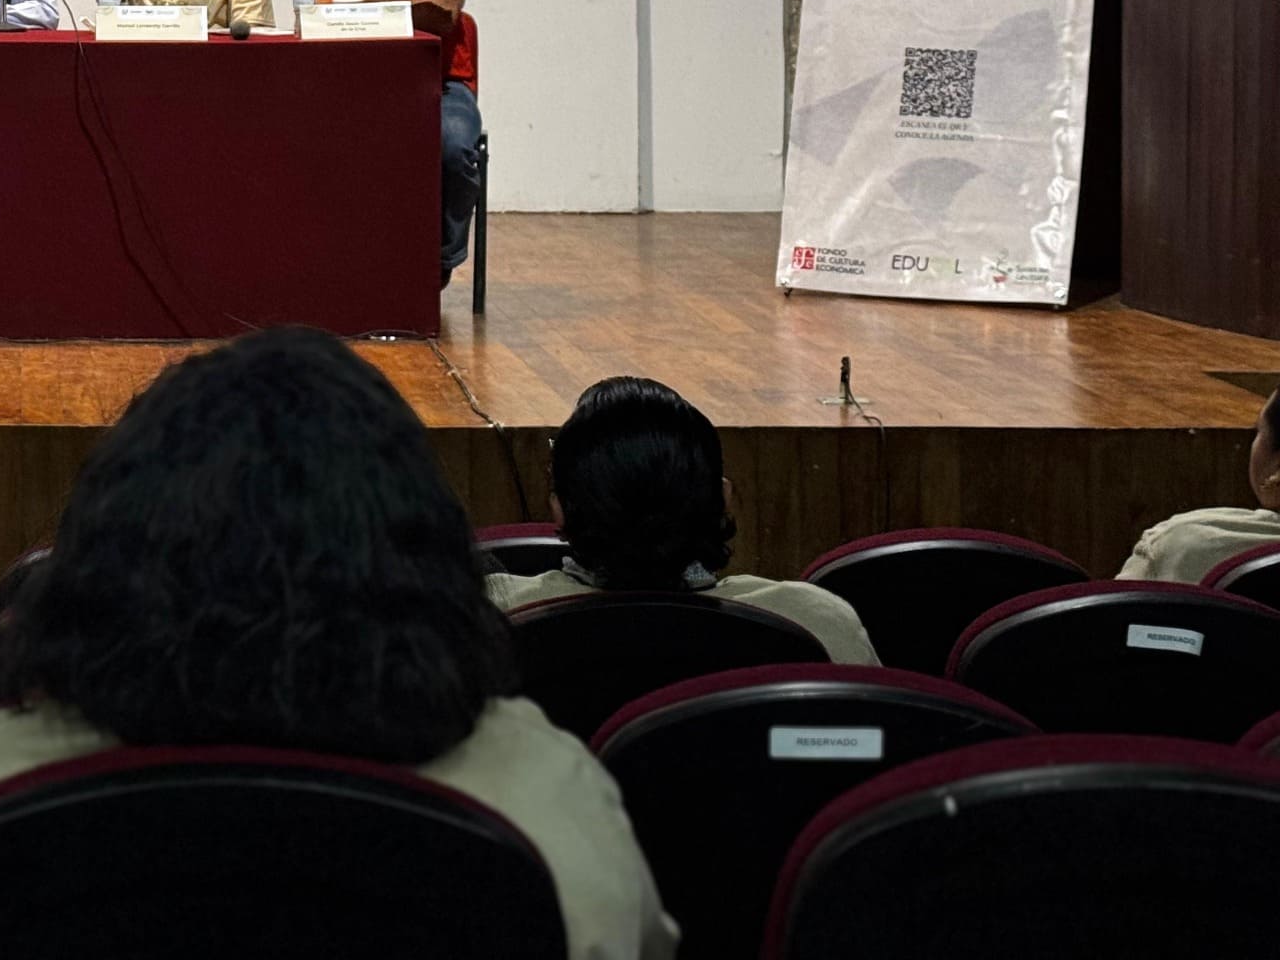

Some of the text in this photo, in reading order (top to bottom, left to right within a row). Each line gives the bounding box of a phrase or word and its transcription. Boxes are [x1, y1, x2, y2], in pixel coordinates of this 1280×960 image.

[817, 247, 847, 257] FONDO
[828, 257, 866, 266] CULTURA
[796, 736, 858, 746] RESERVADO
